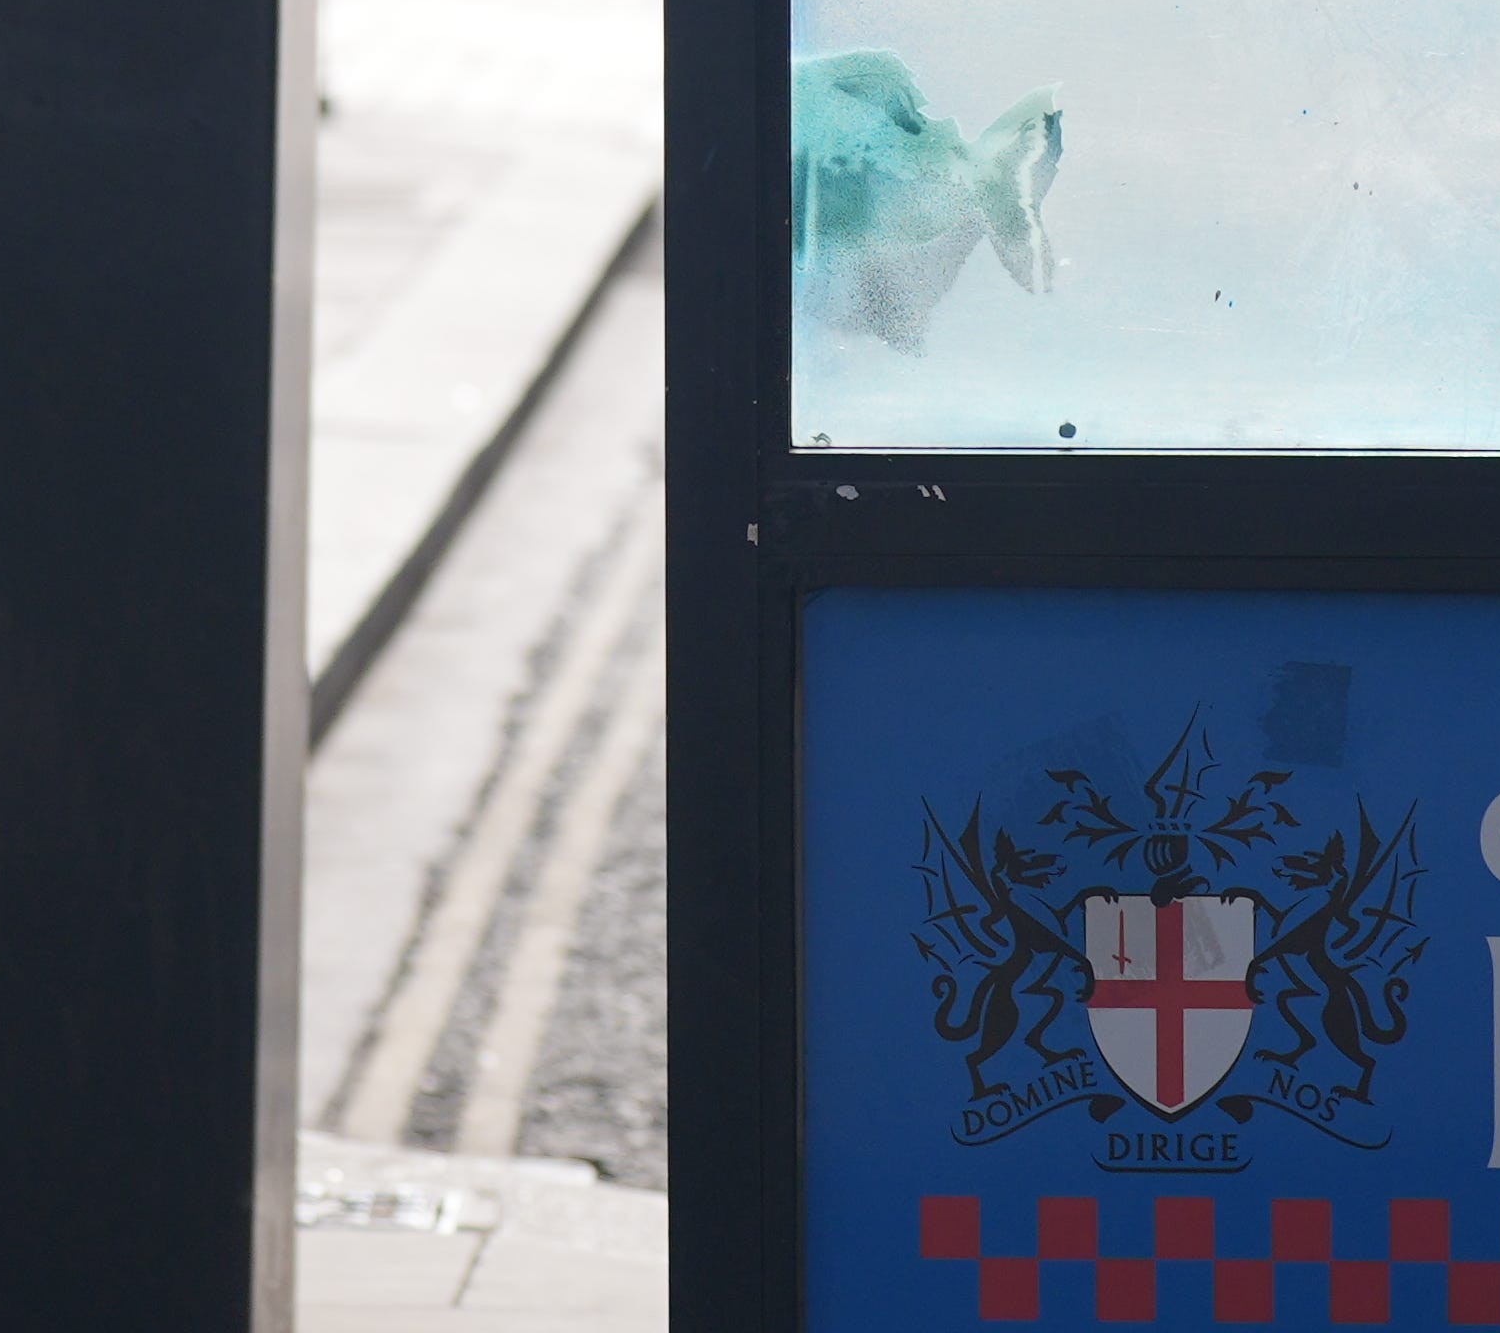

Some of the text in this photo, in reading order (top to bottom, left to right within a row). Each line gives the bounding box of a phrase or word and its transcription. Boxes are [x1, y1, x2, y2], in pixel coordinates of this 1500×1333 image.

[961, 1061, 1341, 1136] DOMINE NOS
[1107, 1134, 1239, 1162] DIRIGE
